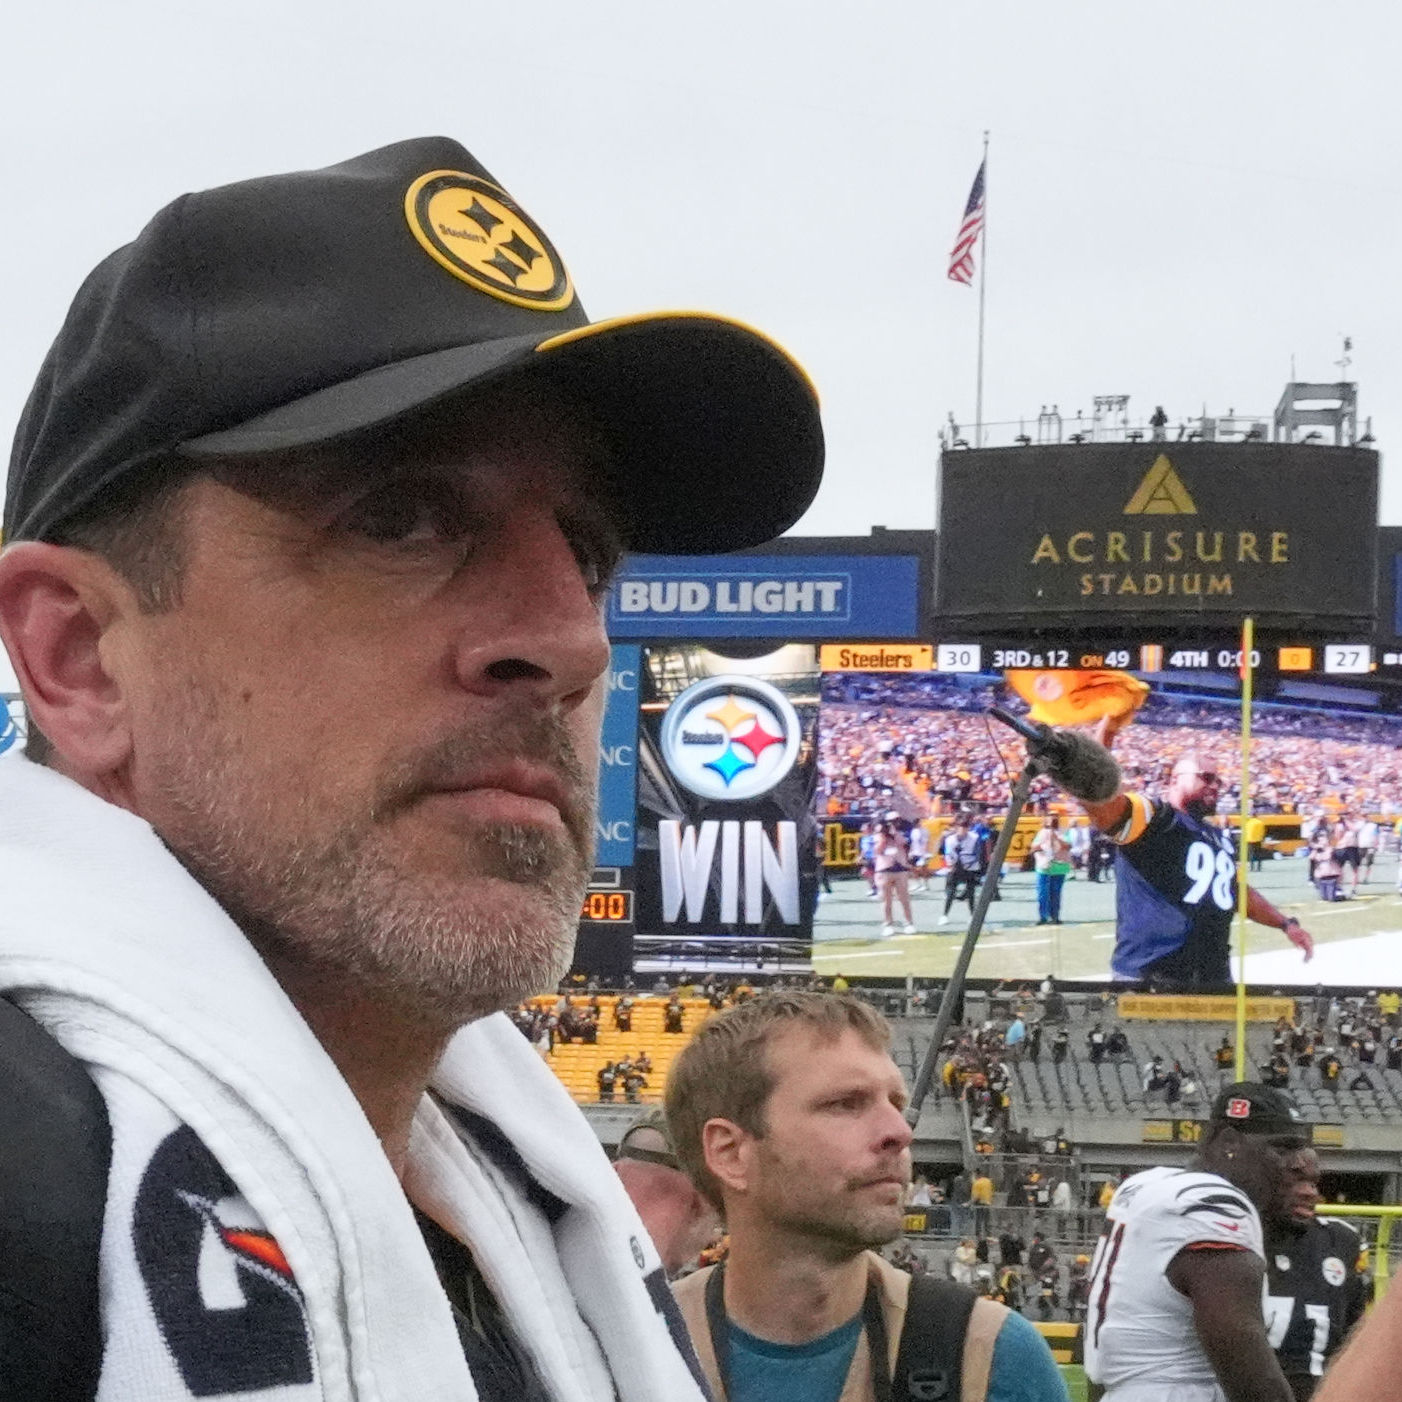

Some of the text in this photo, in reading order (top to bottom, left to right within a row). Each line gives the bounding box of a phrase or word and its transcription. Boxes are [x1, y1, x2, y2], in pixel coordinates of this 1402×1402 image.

[1032, 530, 1290, 566] ACRISURE
[1080, 573, 1234, 596] STADIUM
[620, 581, 842, 613] BUD LIGHT
[839, 648, 913, 669] Steelers
[945, 651, 971, 667] 30
[992, 650, 1032, 667] 3RD
[1048, 650, 1069, 667] 12
[1104, 651, 1130, 667] 49
[1169, 651, 1209, 667] 4TH
[1335, 651, 1360, 667] 27
[608, 670, 636, 692] NC
[599, 745, 632, 767] NC
[598, 820, 631, 842] NC
[658, 819, 796, 925] WIN
[1183, 840, 1235, 911] 98
